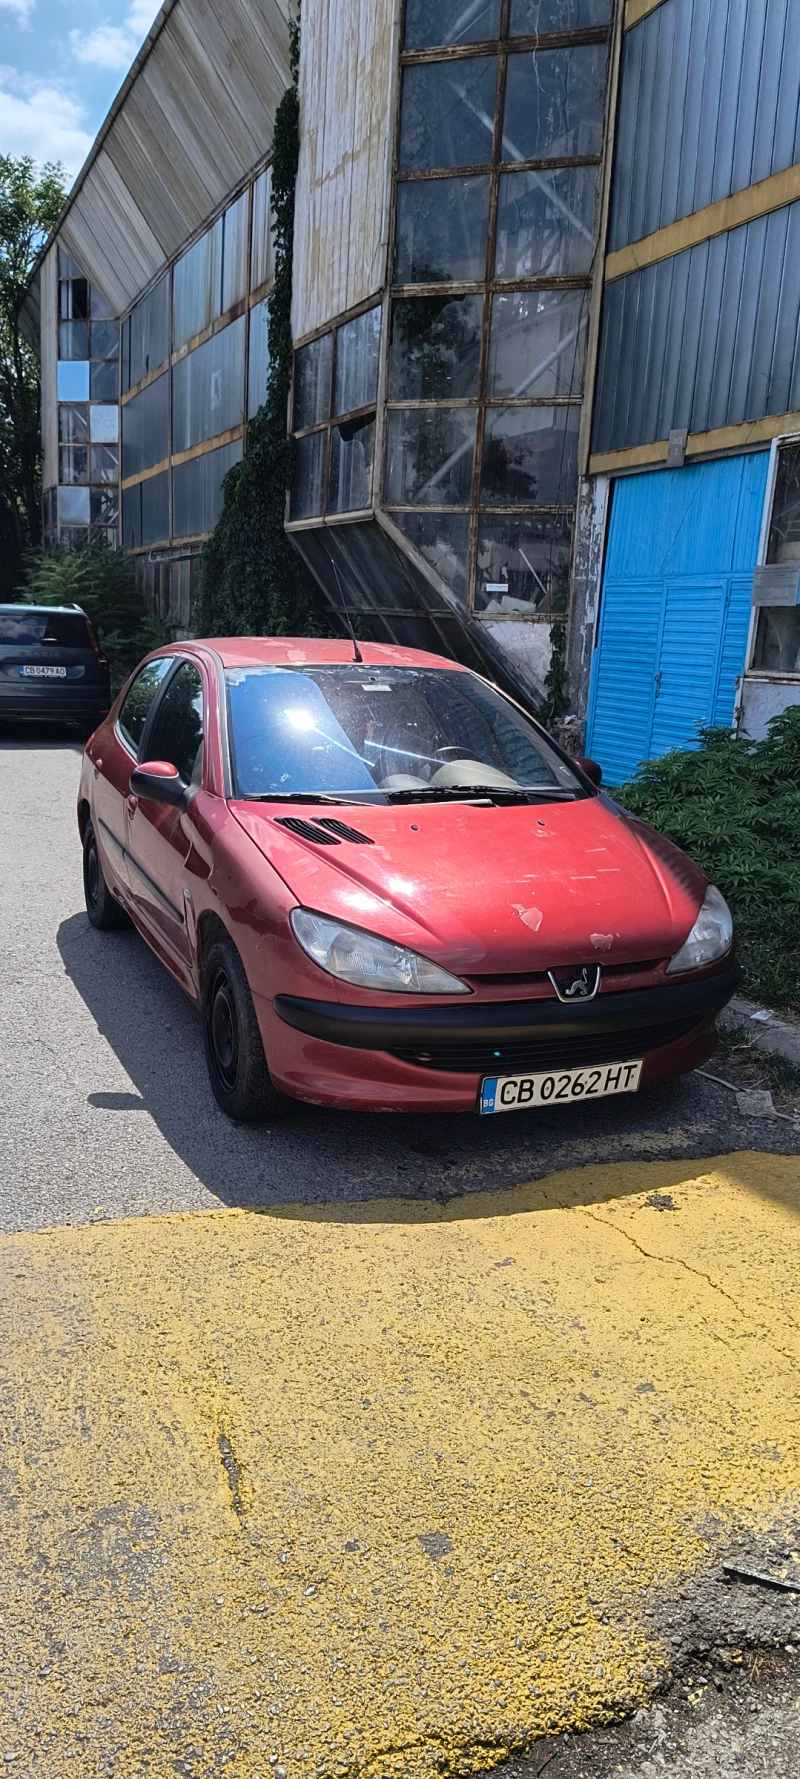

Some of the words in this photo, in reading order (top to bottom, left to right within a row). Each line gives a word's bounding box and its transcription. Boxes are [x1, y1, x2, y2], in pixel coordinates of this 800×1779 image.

[25, 666, 35, 674] CB
[500, 1078, 535, 1105] CB
[540, 1070, 602, 1100] 0262
[603, 1064, 638, 1091] HT
[483, 1098, 494, 1108] BG
